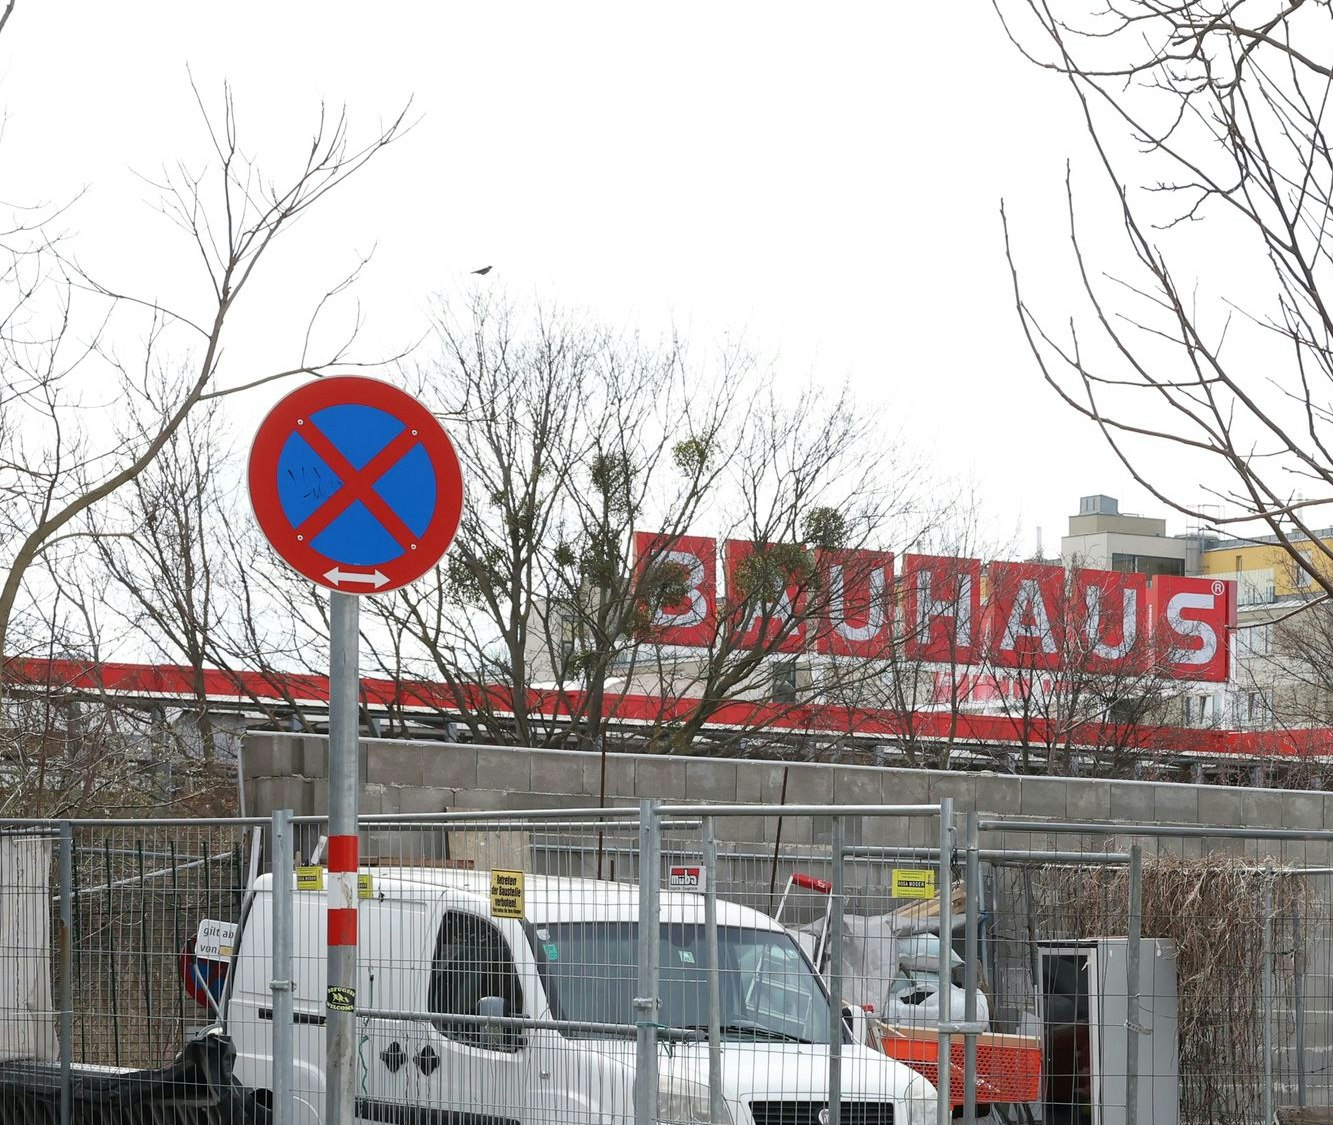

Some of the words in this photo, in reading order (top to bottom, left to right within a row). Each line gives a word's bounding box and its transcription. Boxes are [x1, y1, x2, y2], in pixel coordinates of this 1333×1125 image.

[649, 549, 1217, 664] BAUHAUS
[203, 926, 220, 937] gilt
[222, 930, 234, 939] ab
